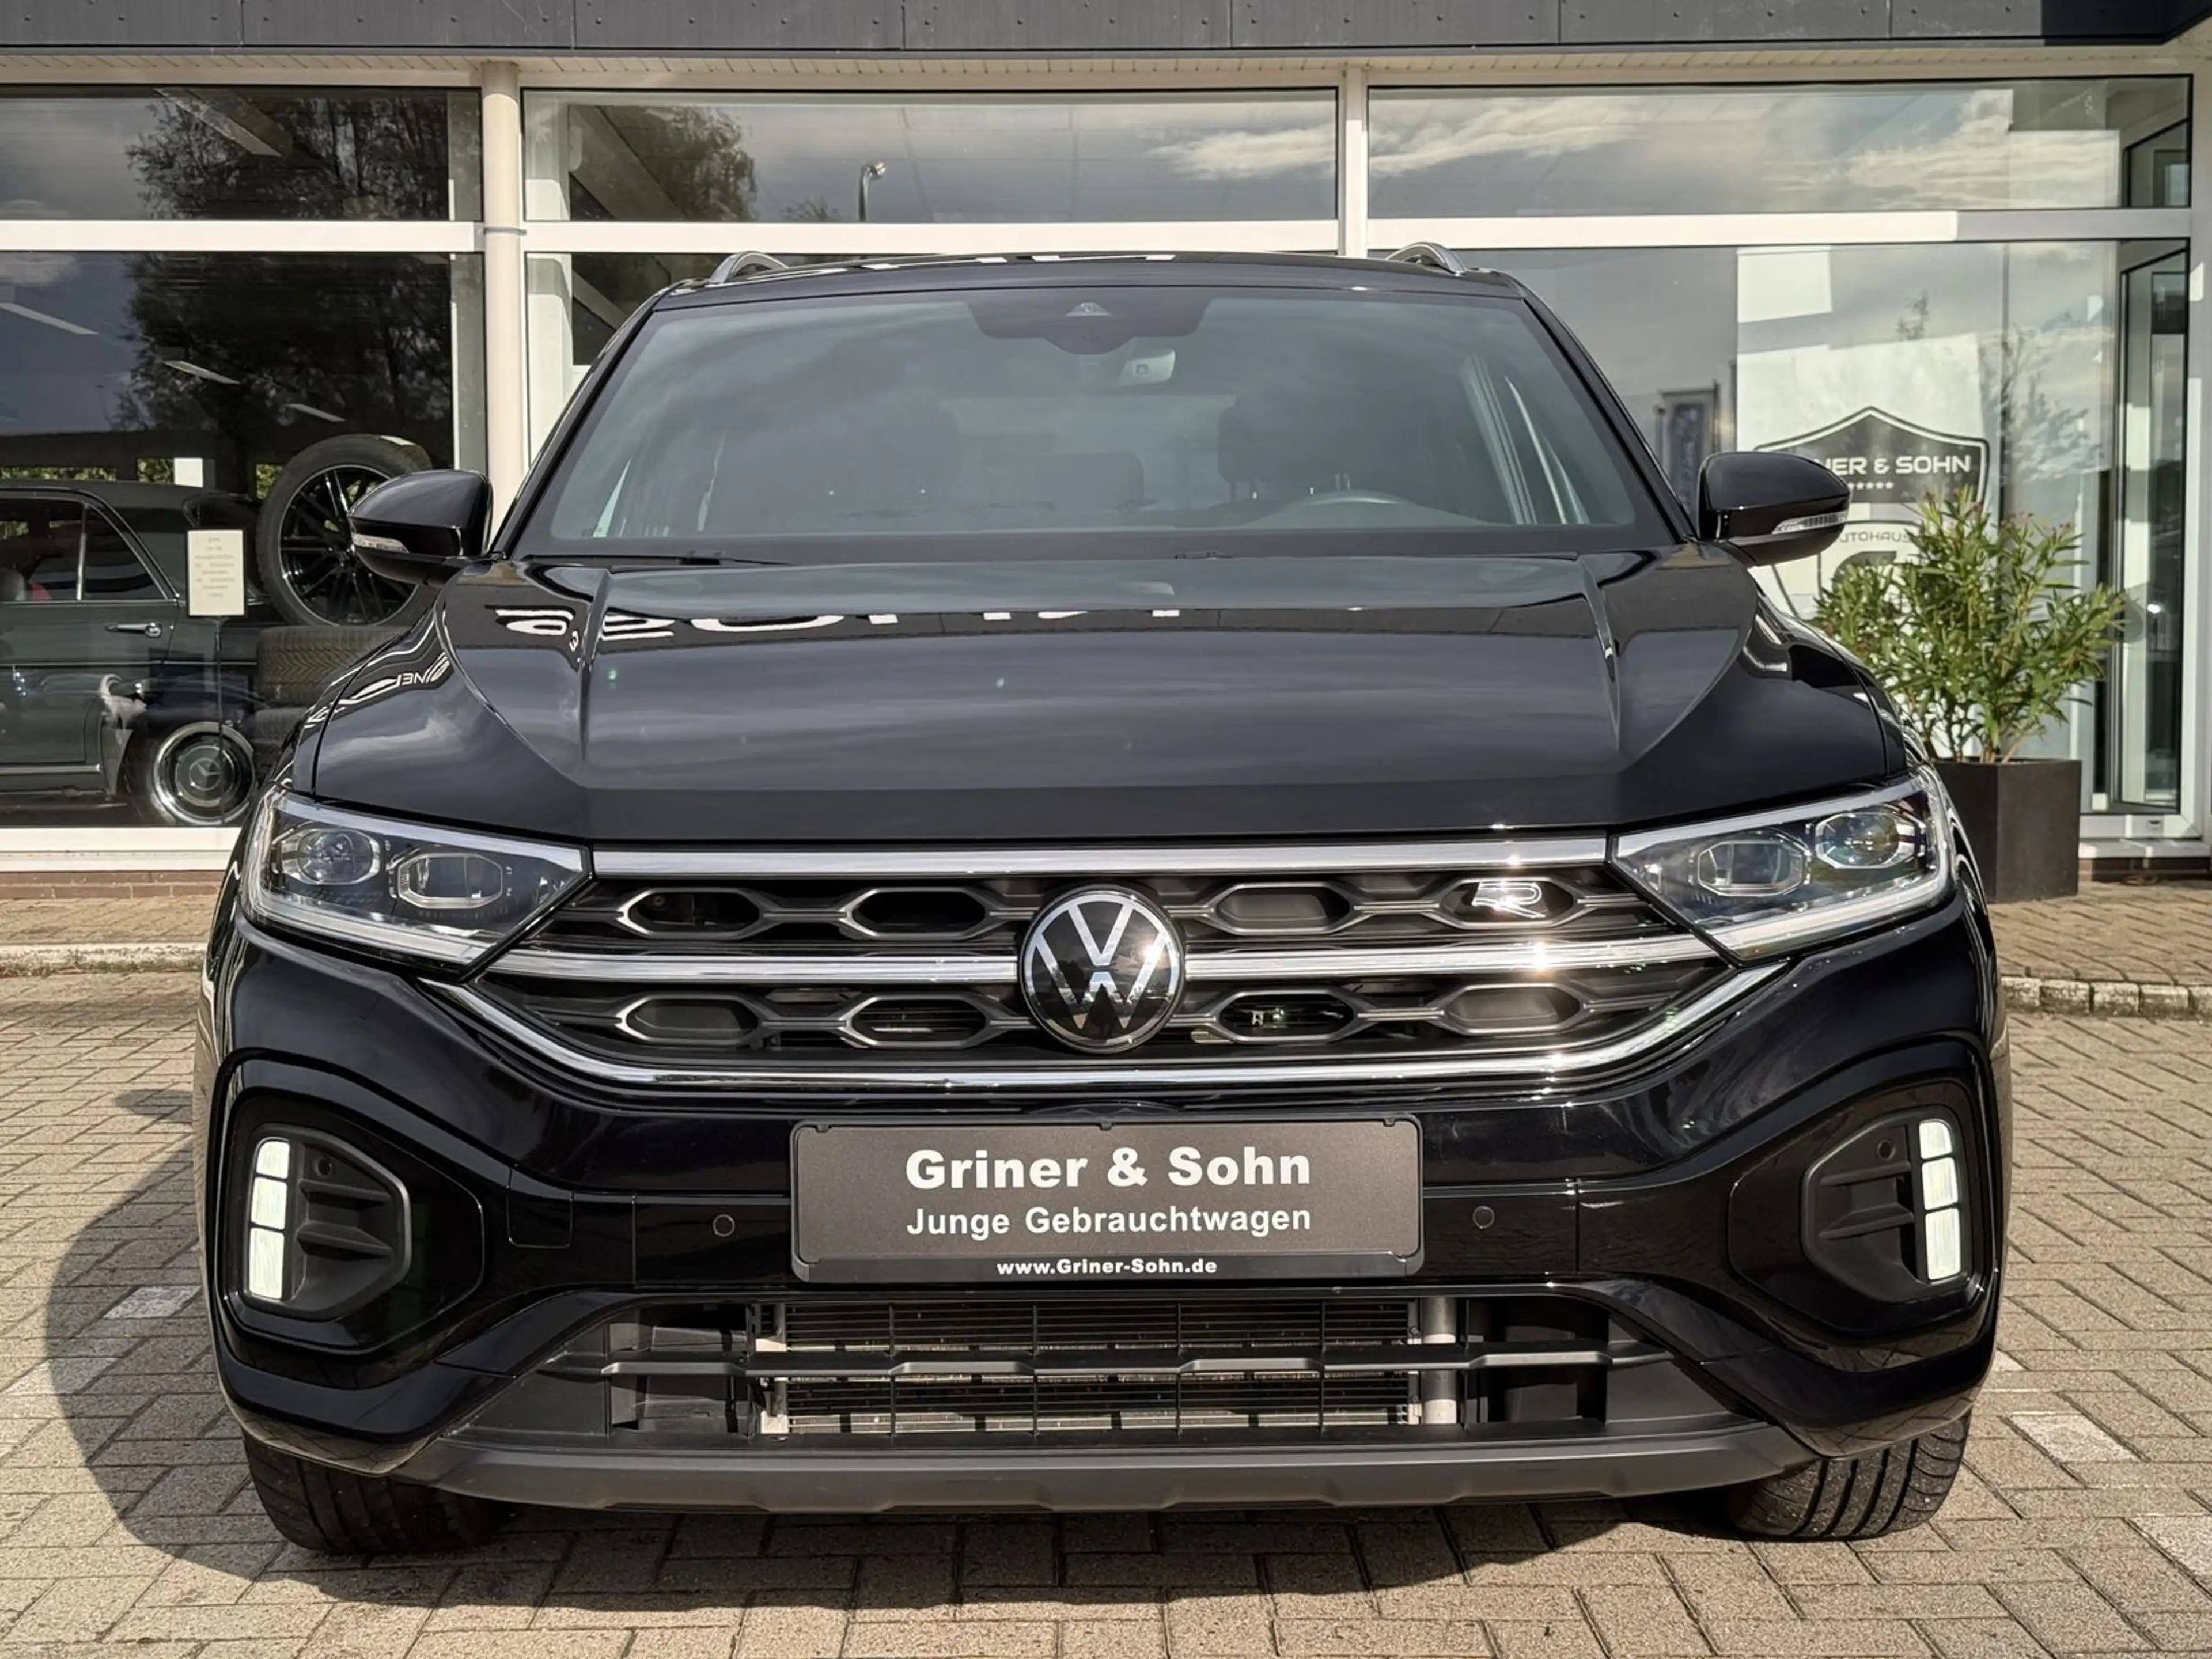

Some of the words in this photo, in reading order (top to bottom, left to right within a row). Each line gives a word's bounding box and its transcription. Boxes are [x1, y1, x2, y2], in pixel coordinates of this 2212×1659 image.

[1874, 457, 1891, 474] &
[1895, 454, 1971, 474] SOHN
[906, 1149, 1089, 1190] Griner
[1107, 1147, 1149, 1187] &
[1168, 1146, 1310, 1187] Sohn
[907, 1207, 1010, 1241] Junge
[1025, 1205, 1310, 1237] Gebrauchtwagen
[996, 1257, 1218, 1275] www.Griner-Sohn.de
